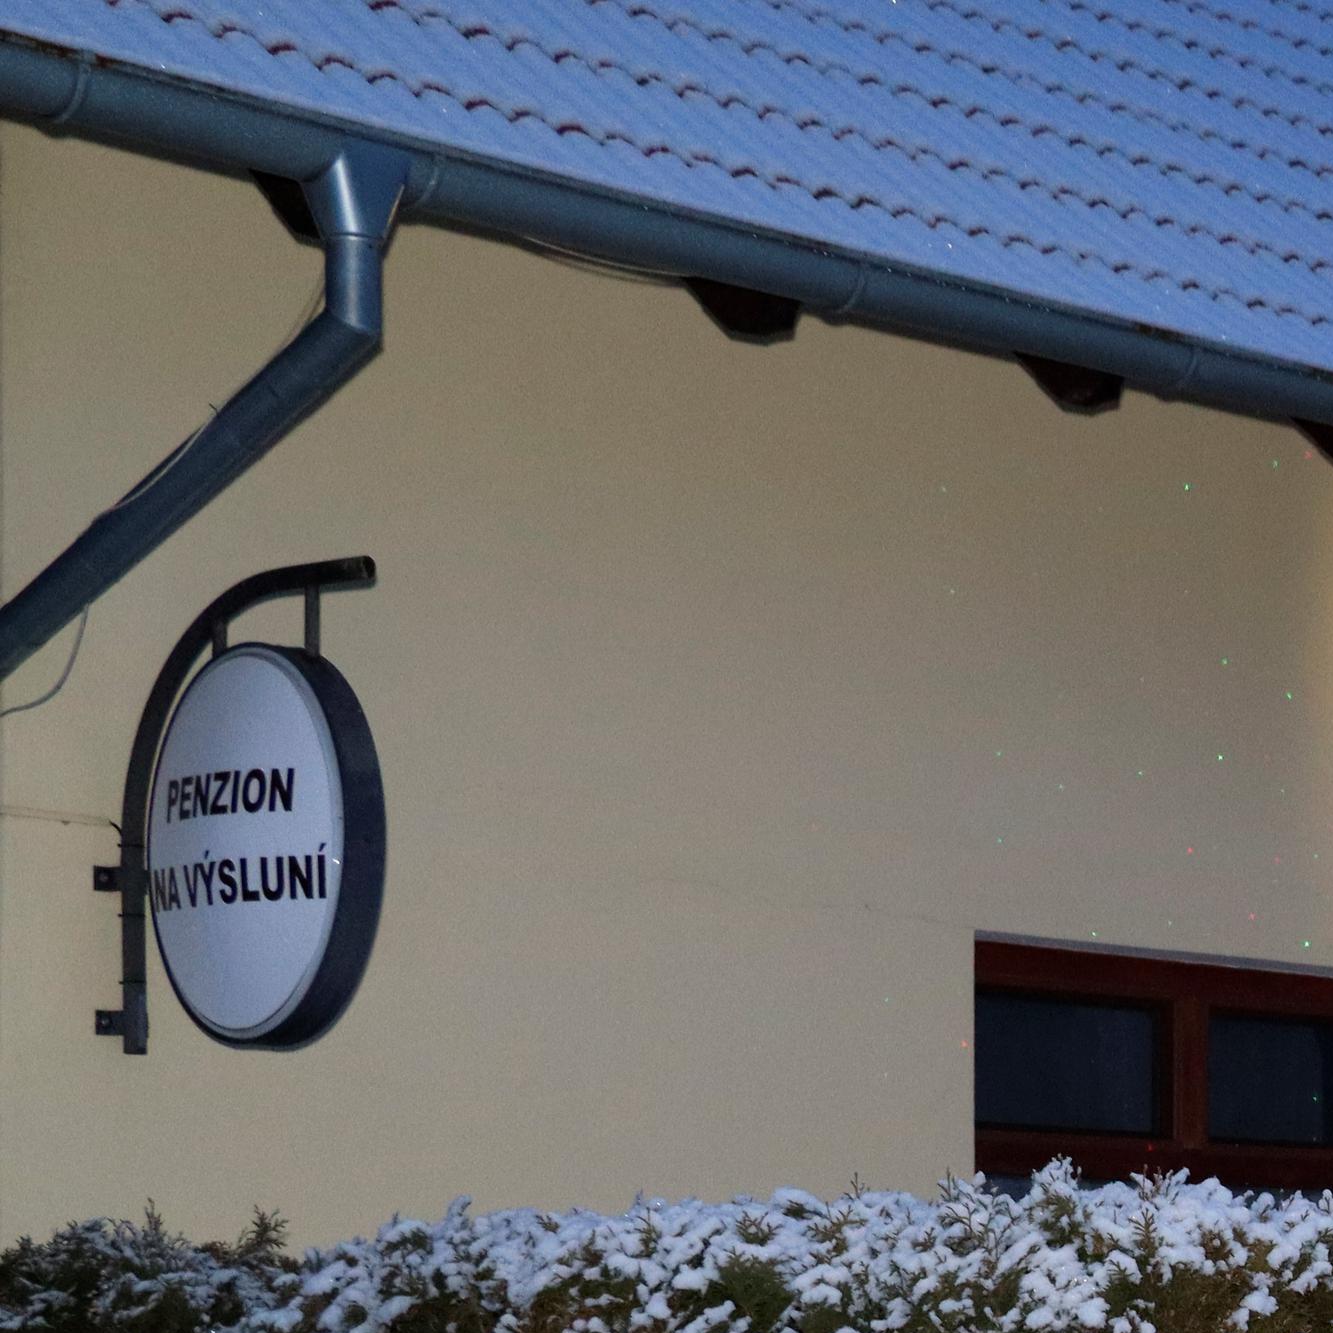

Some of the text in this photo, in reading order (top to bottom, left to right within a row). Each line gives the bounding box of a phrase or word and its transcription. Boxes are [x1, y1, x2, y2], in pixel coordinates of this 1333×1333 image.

[167, 768, 294, 822] PENZION
[153, 843, 327, 912] NA VÝSLUNÍ
